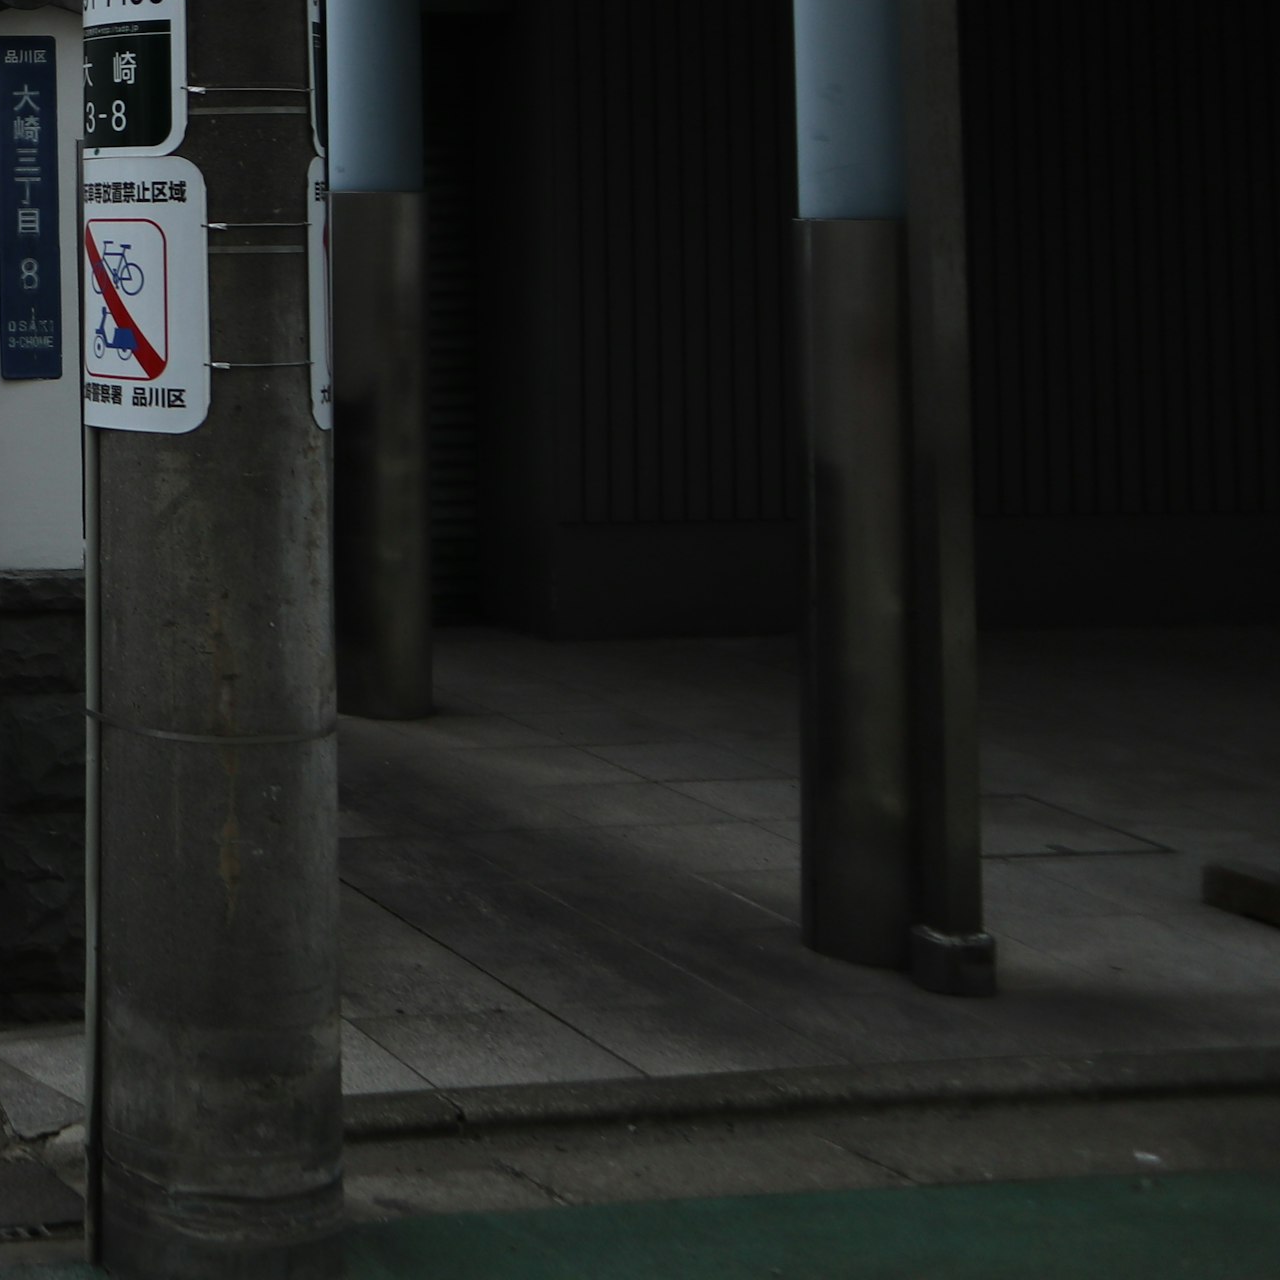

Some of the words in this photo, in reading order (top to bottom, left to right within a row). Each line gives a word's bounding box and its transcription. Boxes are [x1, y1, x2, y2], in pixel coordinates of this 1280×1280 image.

[5, 50, 47, 63] 品川区
[86, 100, 127, 134] 3-8
[13, 84, 41, 235] 大崎三丁目
[132, 388, 186, 408] 品川区
